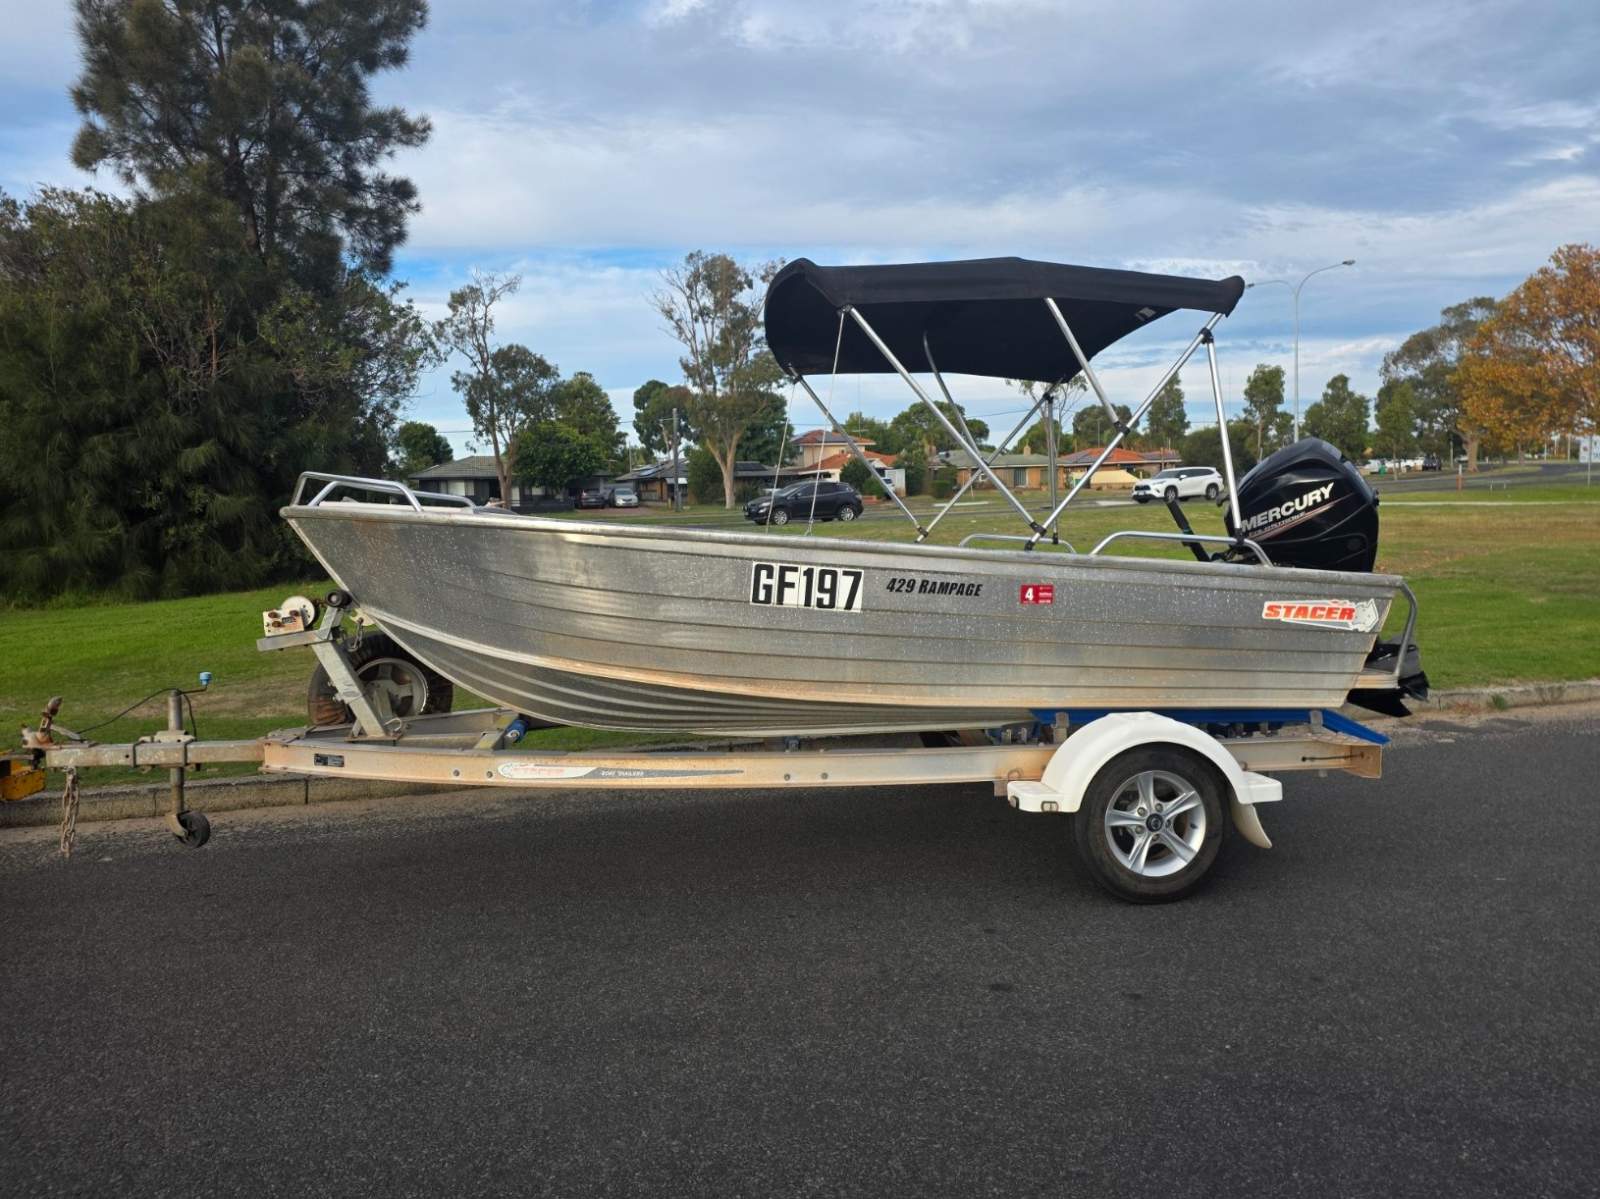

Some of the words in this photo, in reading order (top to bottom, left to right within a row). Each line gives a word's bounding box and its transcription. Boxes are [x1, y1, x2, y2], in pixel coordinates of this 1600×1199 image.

[1241, 482, 1334, 532] MERCURY
[752, 563, 863, 611] GF197
[886, 578, 915, 593] 429
[918, 579, 983, 597] RAMPAGE
[1025, 587, 1034, 601] 4
[1264, 605, 1356, 621] STACER
